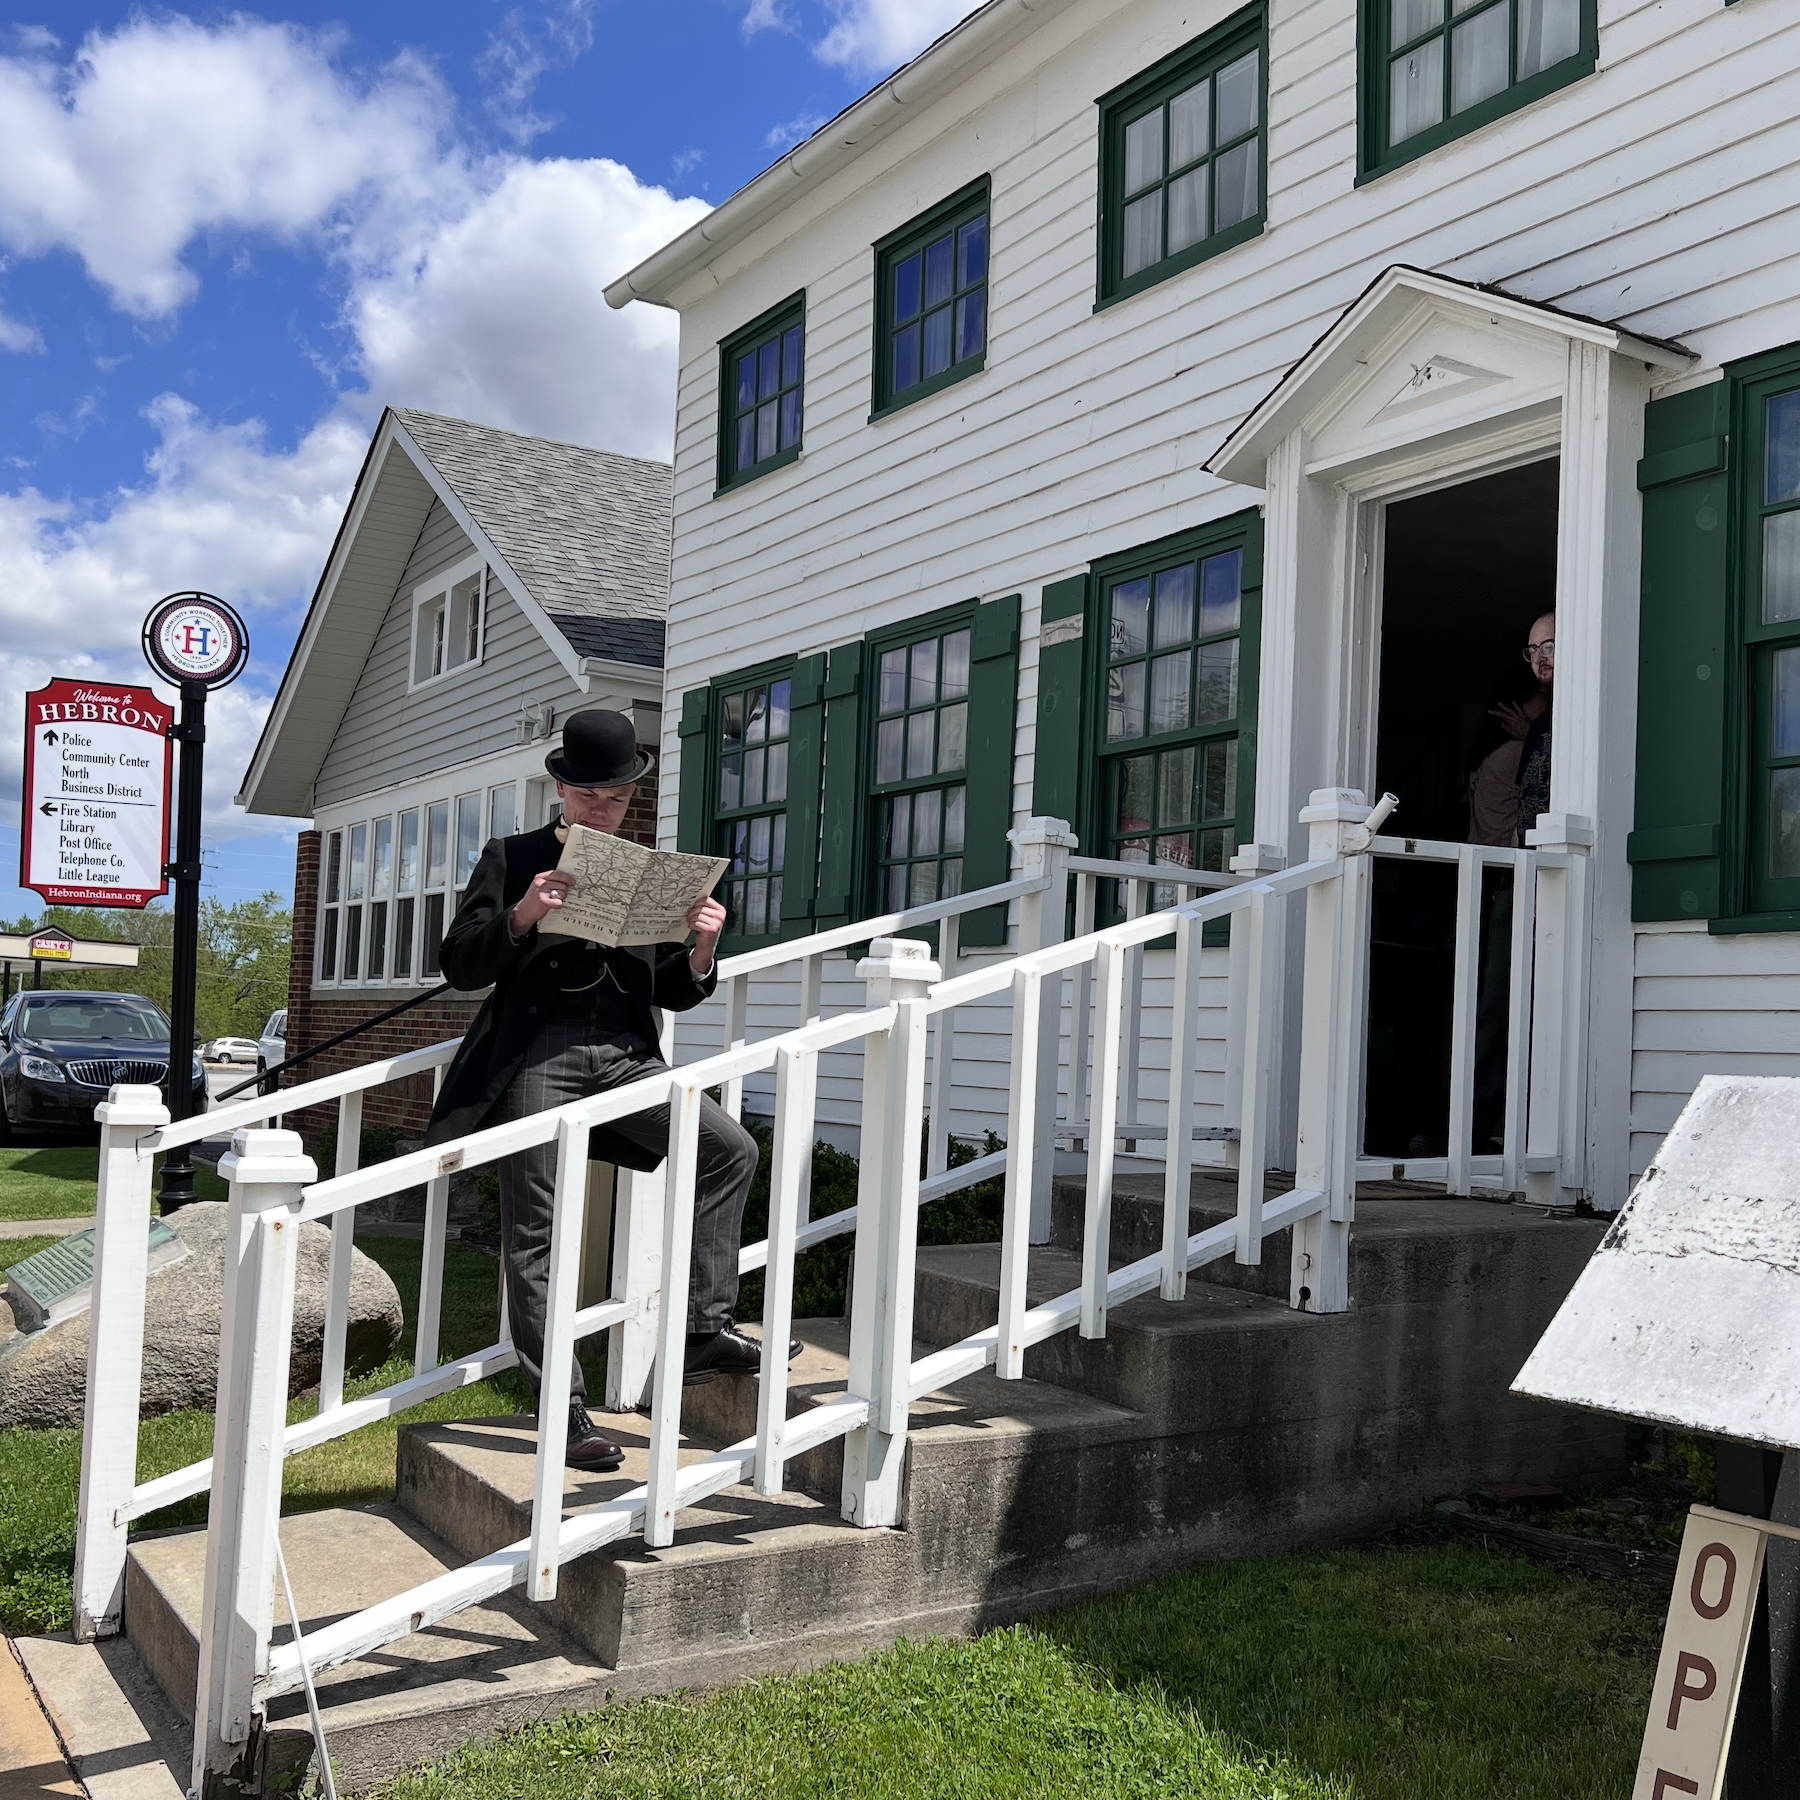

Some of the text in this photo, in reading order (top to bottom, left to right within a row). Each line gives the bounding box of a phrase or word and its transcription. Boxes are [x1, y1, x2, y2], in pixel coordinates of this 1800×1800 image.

[165, 610, 188, 637] COMMUNITY
[189, 609, 216, 621] WORKING
[215, 620, 229, 649] TOGETHER
[181, 625, 211, 656] H
[197, 657, 221, 670] INDIANA
[73, 688, 133, 706] Welcome to
[37, 702, 164, 731] HEBRON
[62, 732, 92, 747] Police
[62, 748, 150, 768] Community Center
[61, 765, 89, 779] North
[61, 779, 142, 798] Business District
[60, 803, 117, 819] Fire Station
[60, 819, 95, 836] Library
[59, 835, 112, 851] Post Office
[59, 851, 126, 868] Telephone Co.
[58, 867, 120, 884] Little League
[48, 887, 142, 903] HebronIndiana.org
[562, 906, 588, 915] LANDIN
[562, 916, 604, 932] HERALD
[35, 939, 69, 950] CASEY'S
